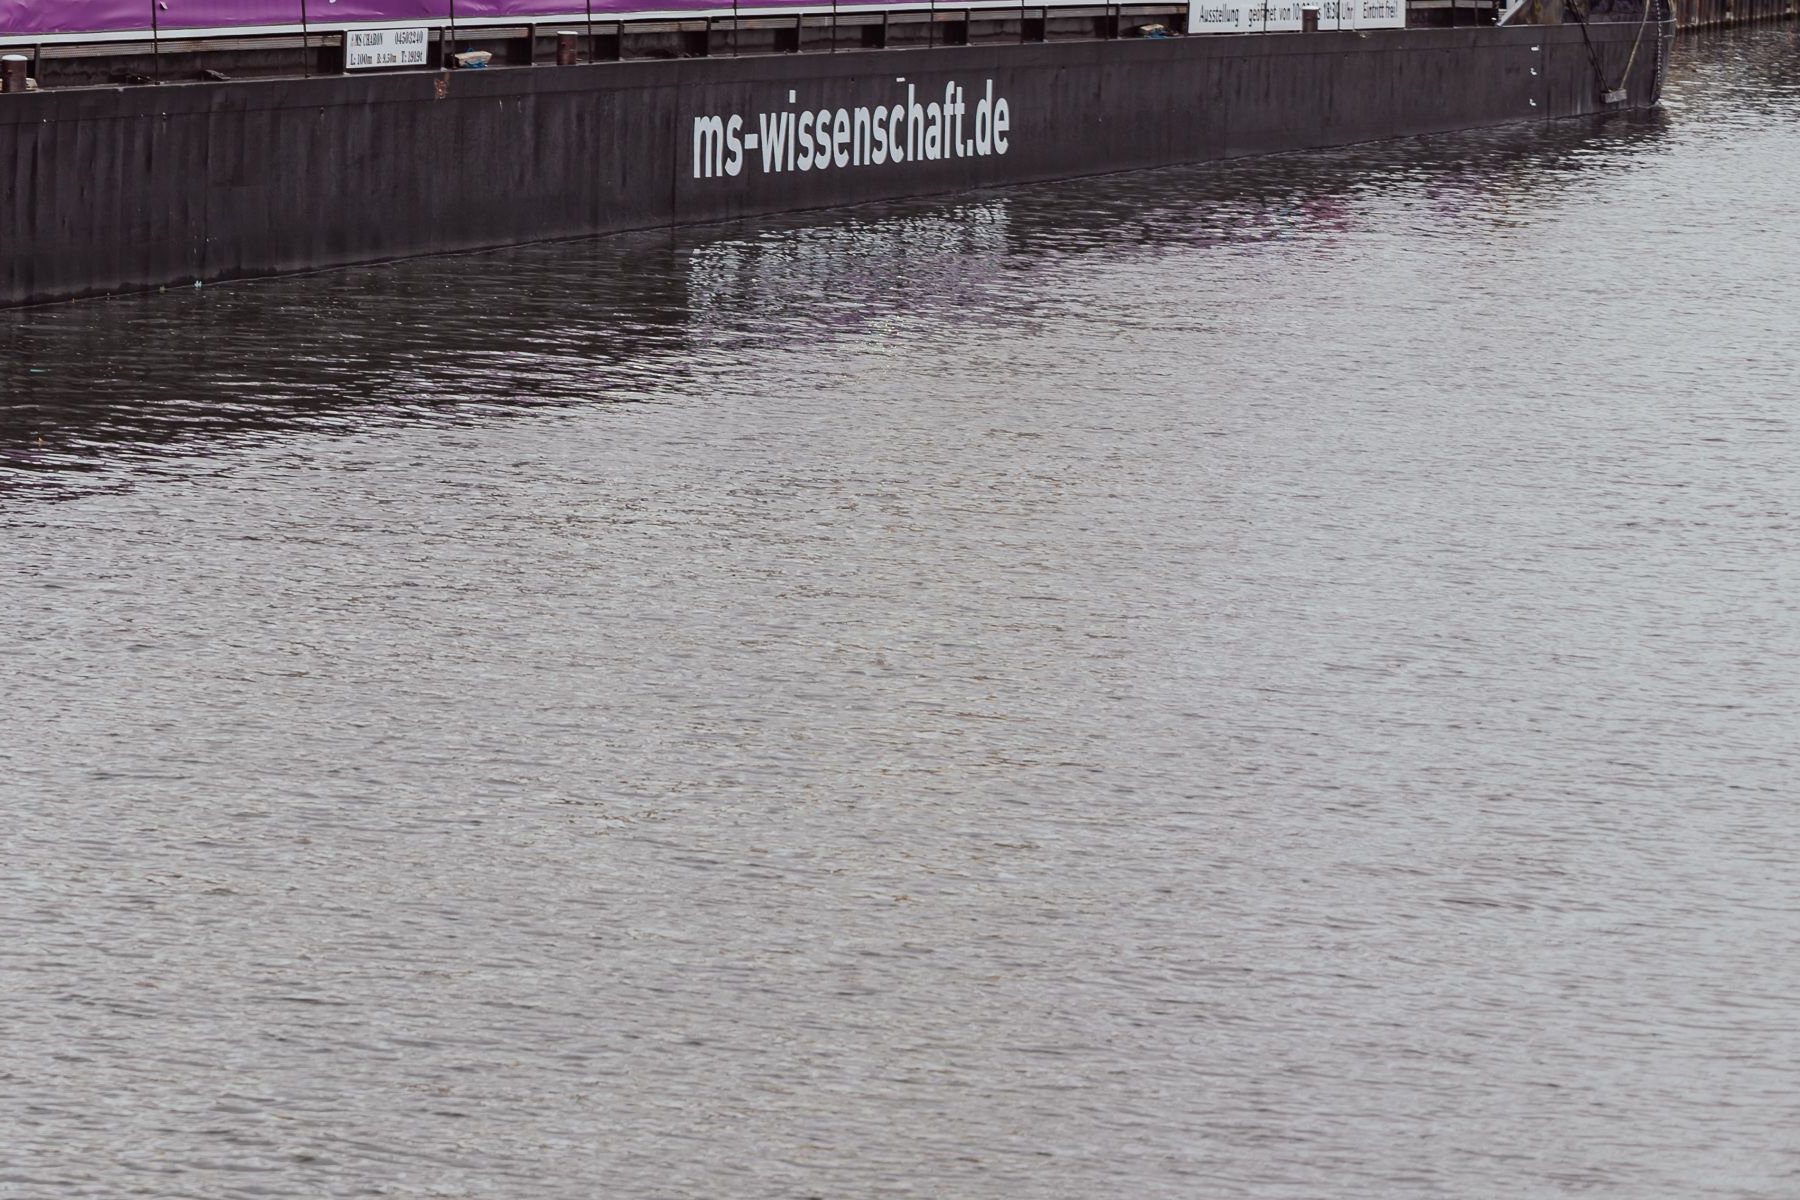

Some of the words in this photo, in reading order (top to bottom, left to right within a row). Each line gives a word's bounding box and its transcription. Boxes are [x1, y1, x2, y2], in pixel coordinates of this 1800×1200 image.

[1199, 3, 1239, 27] Ausstellung
[1279, 6, 1291, 21] von
[1342, 1, 1353, 20] Uhr
[1362, 1, 1385, 20] Eintritt
[1385, 0, 1398, 18] frei!
[362, 32, 384, 47] CHARON
[693, 78, 1010, 179] ms-wissenschaft.de
